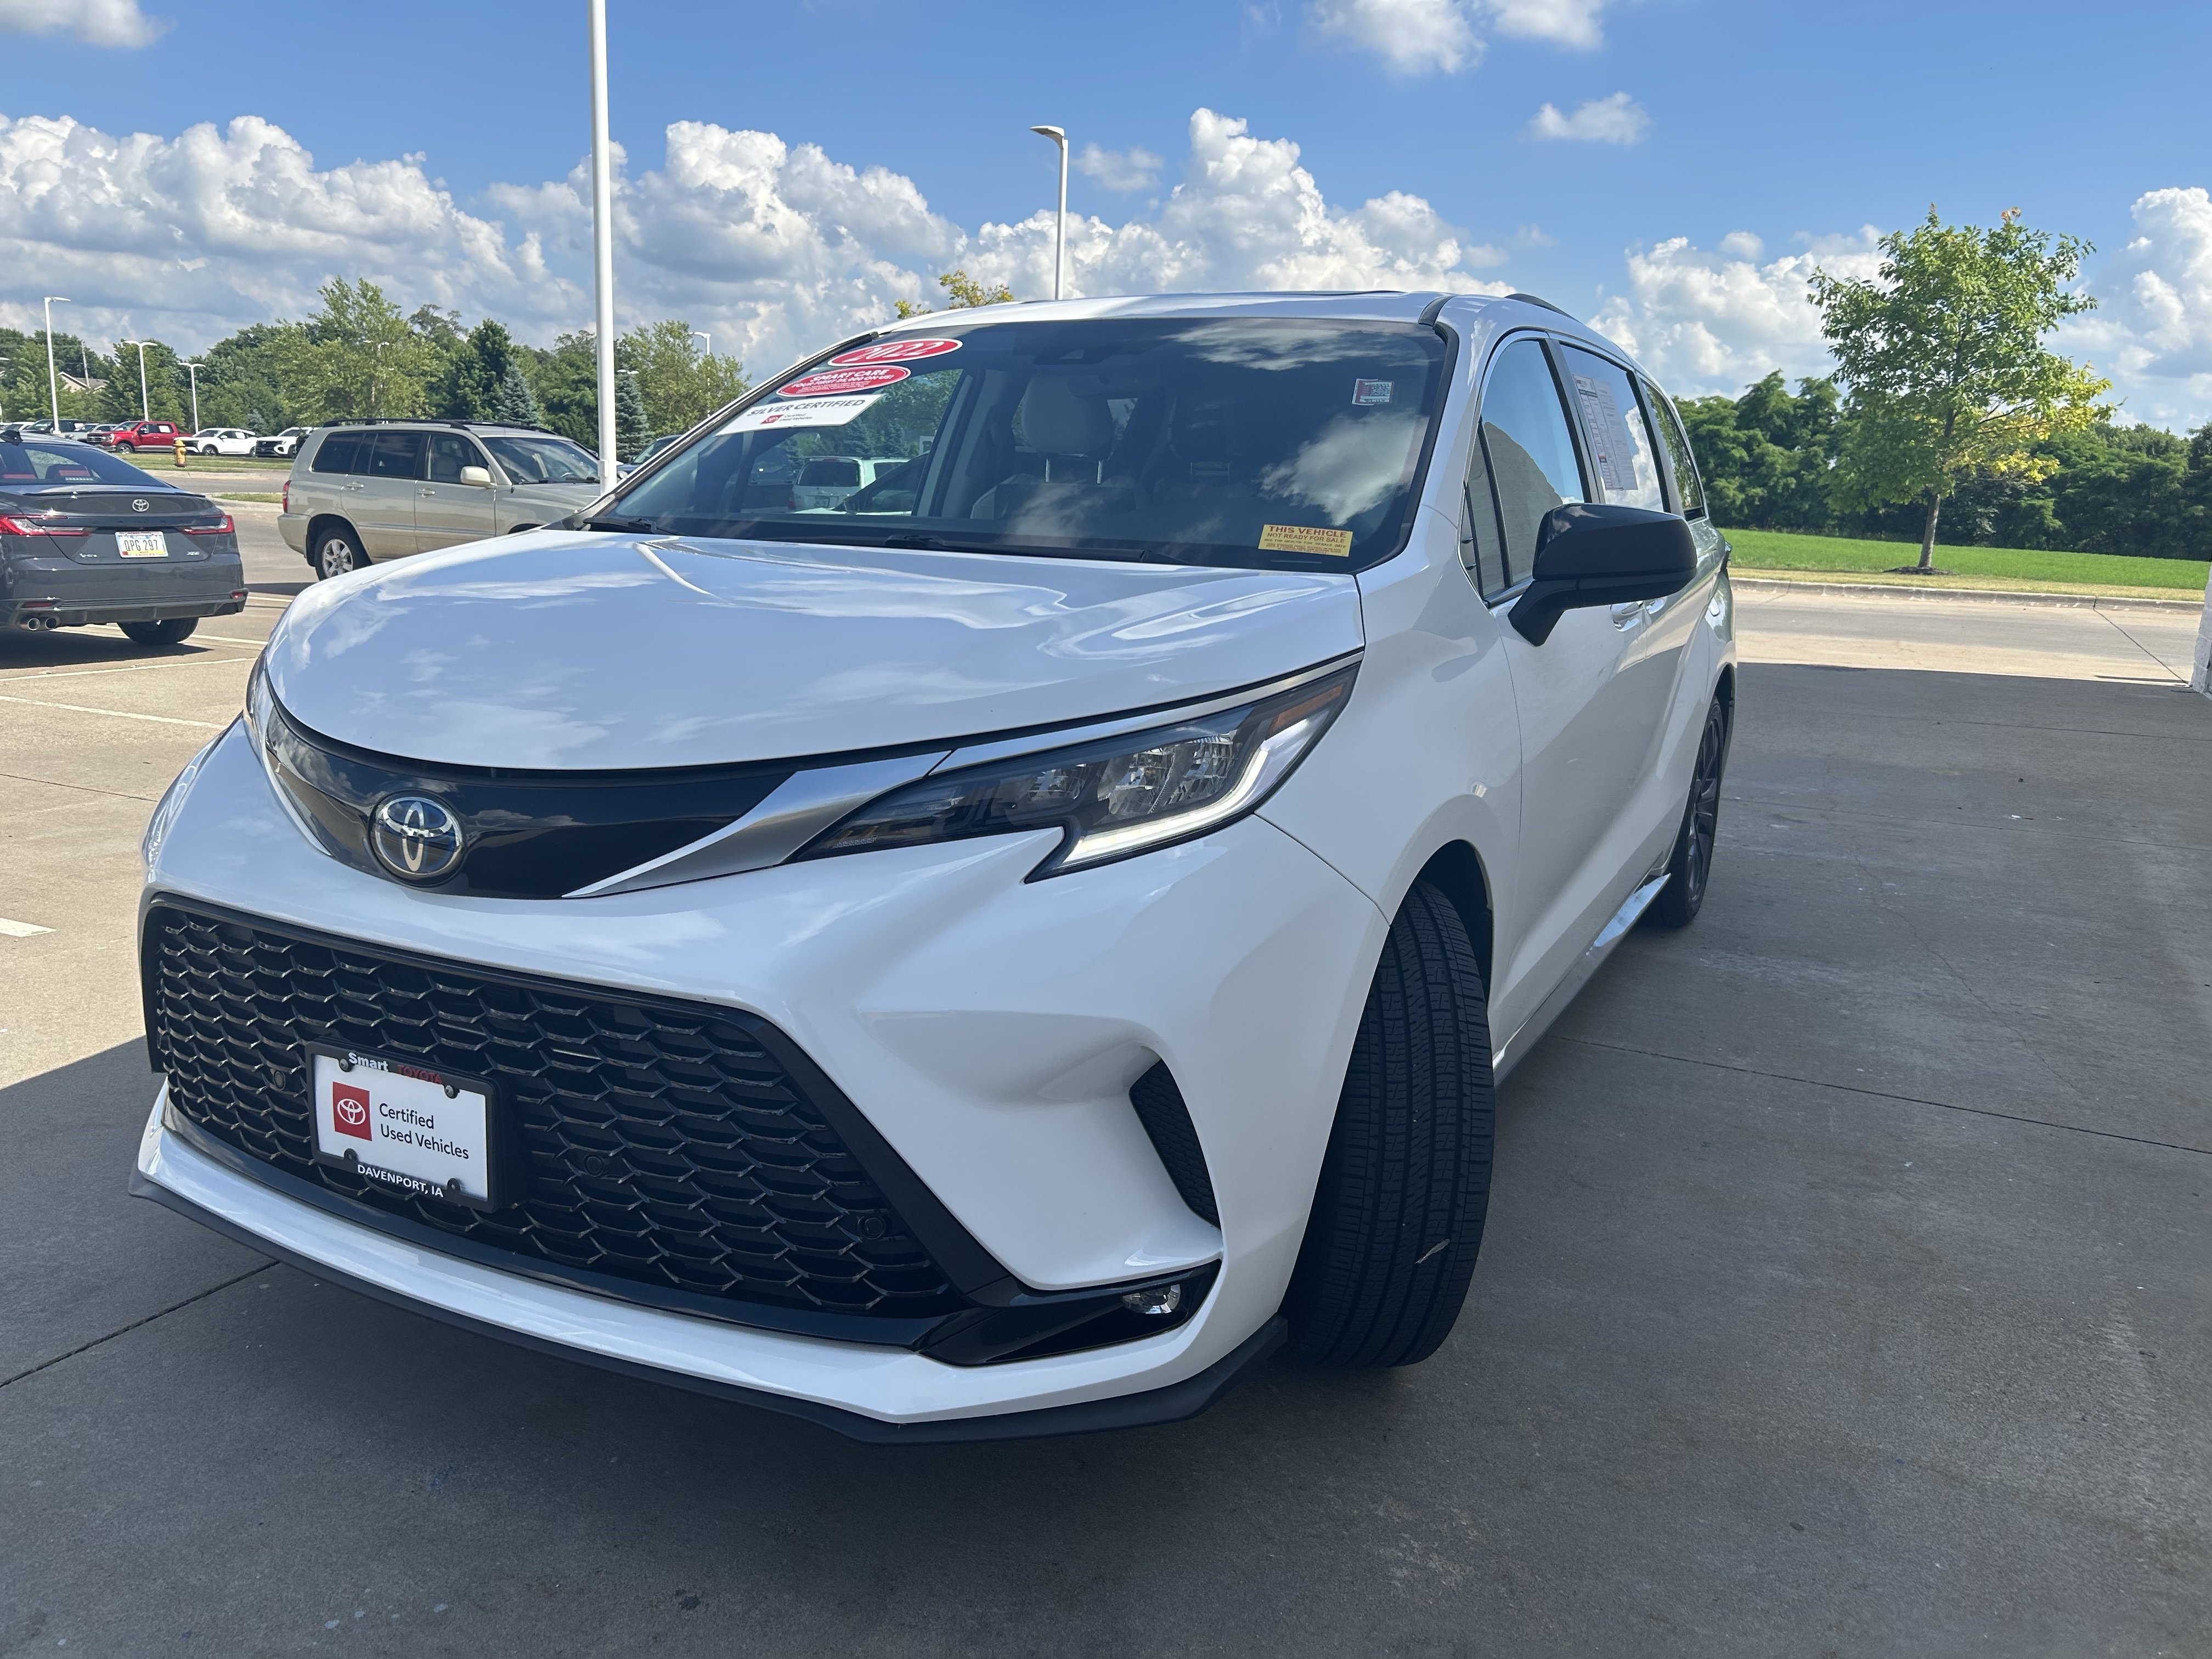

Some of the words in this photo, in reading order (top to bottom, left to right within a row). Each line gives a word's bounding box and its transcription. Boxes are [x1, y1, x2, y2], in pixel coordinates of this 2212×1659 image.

[842, 341, 945, 363] 2022
[810, 372, 856, 382] SMART
[747, 405, 794, 416] SILVER
[794, 399, 866, 410] CERTIFIED
[1298, 527, 1347, 538] VEHICLE
[124, 539, 141, 551] QPG
[143, 539, 158, 551] 297
[348, 1052, 388, 1072] Smart
[397, 1064, 442, 1085] TOYOTA
[379, 1103, 434, 1129] Certified
[381, 1123, 413, 1144] Used
[415, 1132, 469, 1159] Vehicles
[357, 1164, 428, 1195] DAVENPORT,
[431, 1186, 444, 1198] IA
